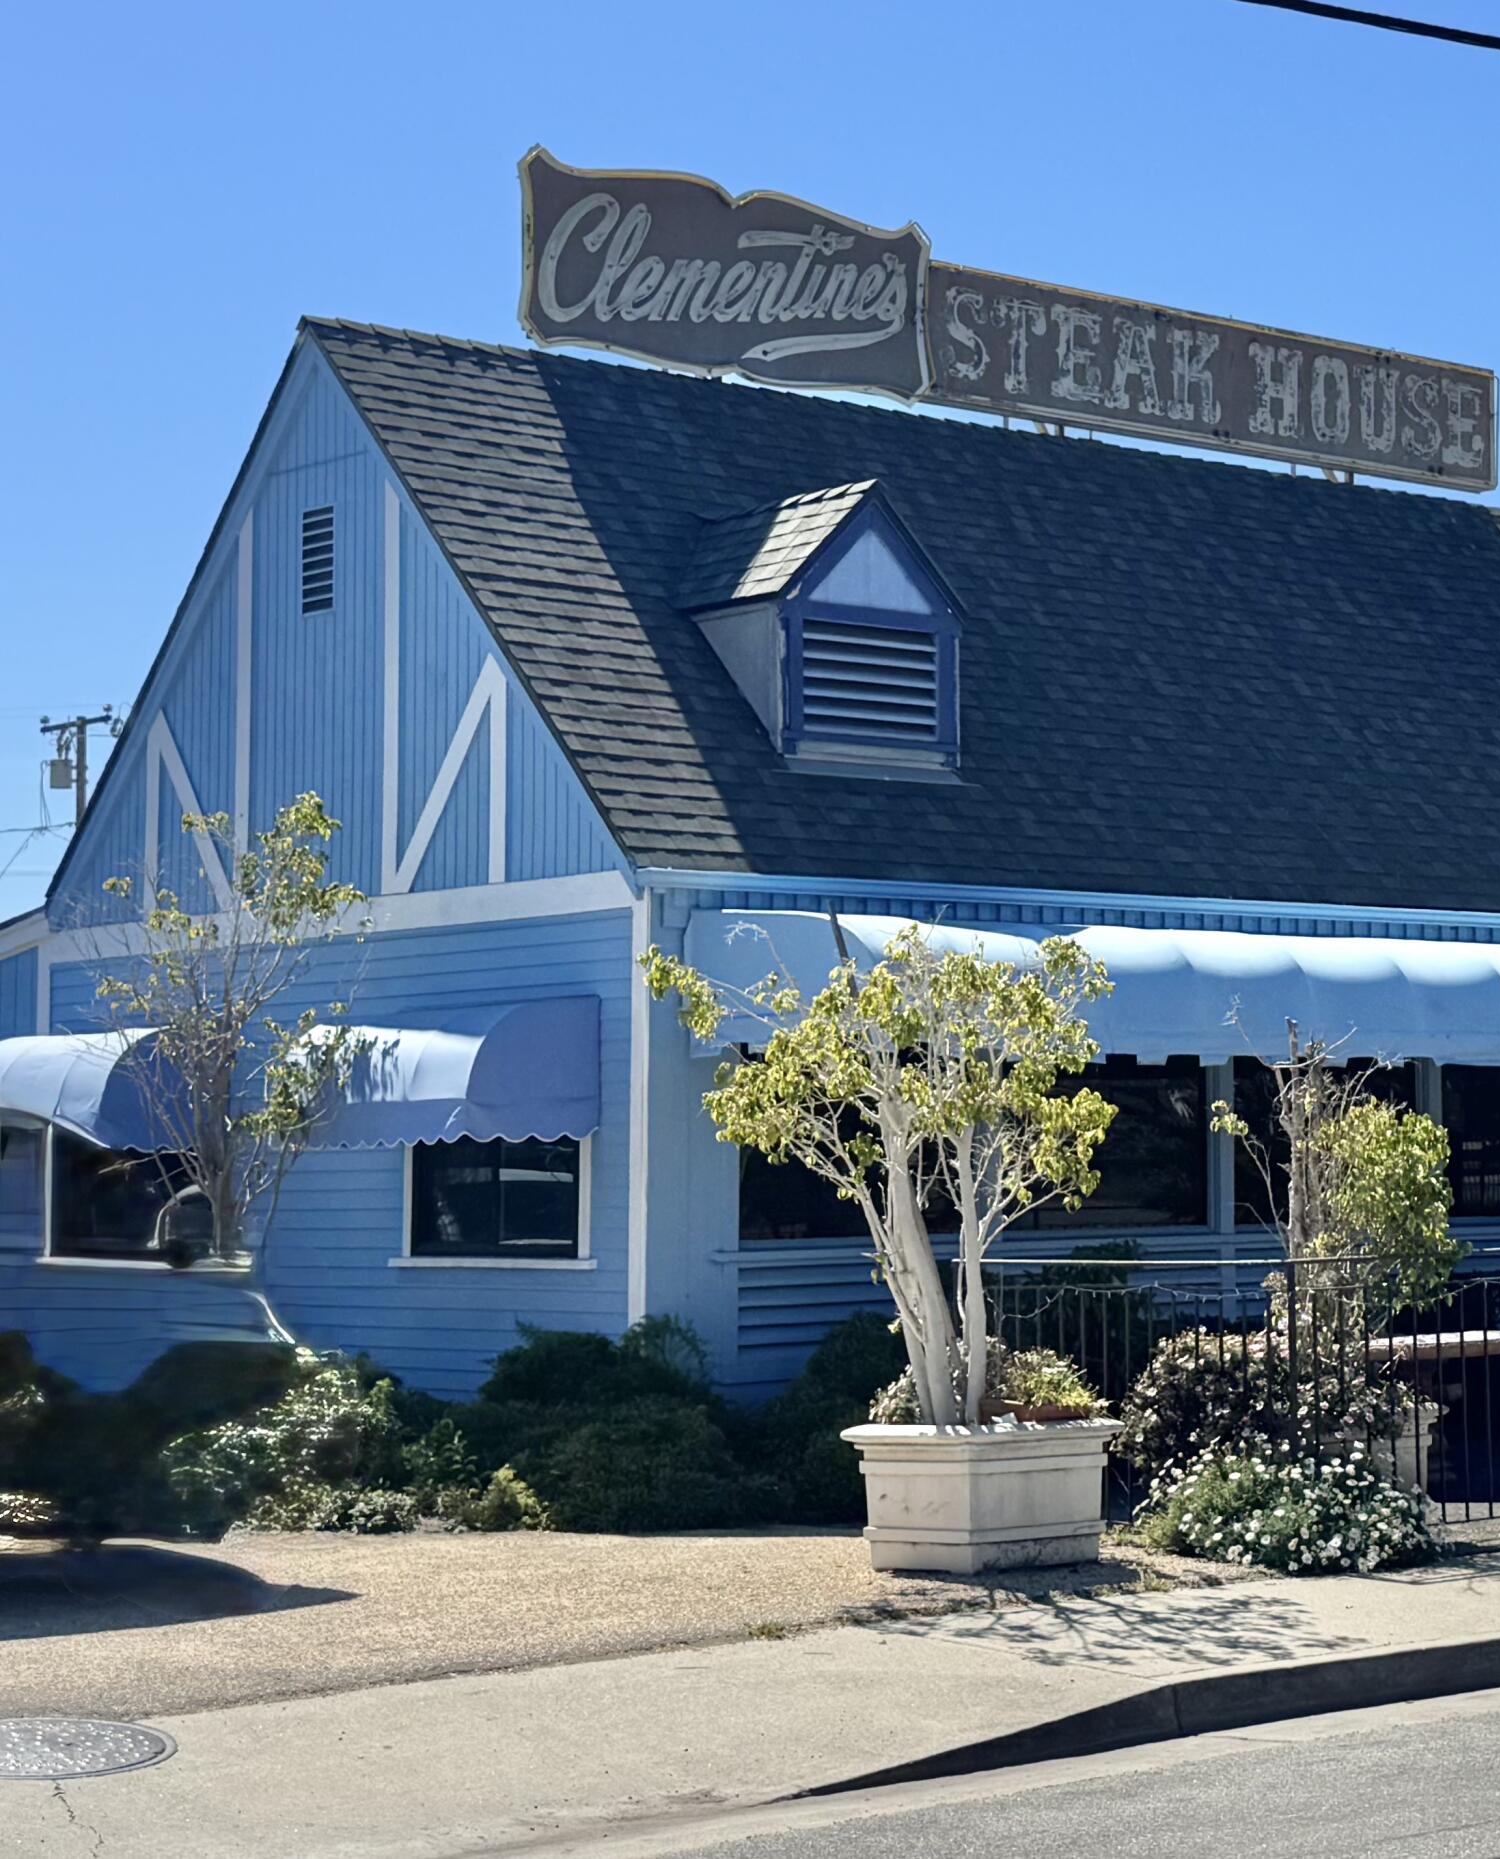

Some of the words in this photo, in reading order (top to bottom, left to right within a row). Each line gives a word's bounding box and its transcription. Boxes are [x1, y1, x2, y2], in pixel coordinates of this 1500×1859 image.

[538, 193, 907, 361] Clementine's
[940, 286, 1221, 424] STEAK
[1249, 342, 1484, 468] HOUSE
